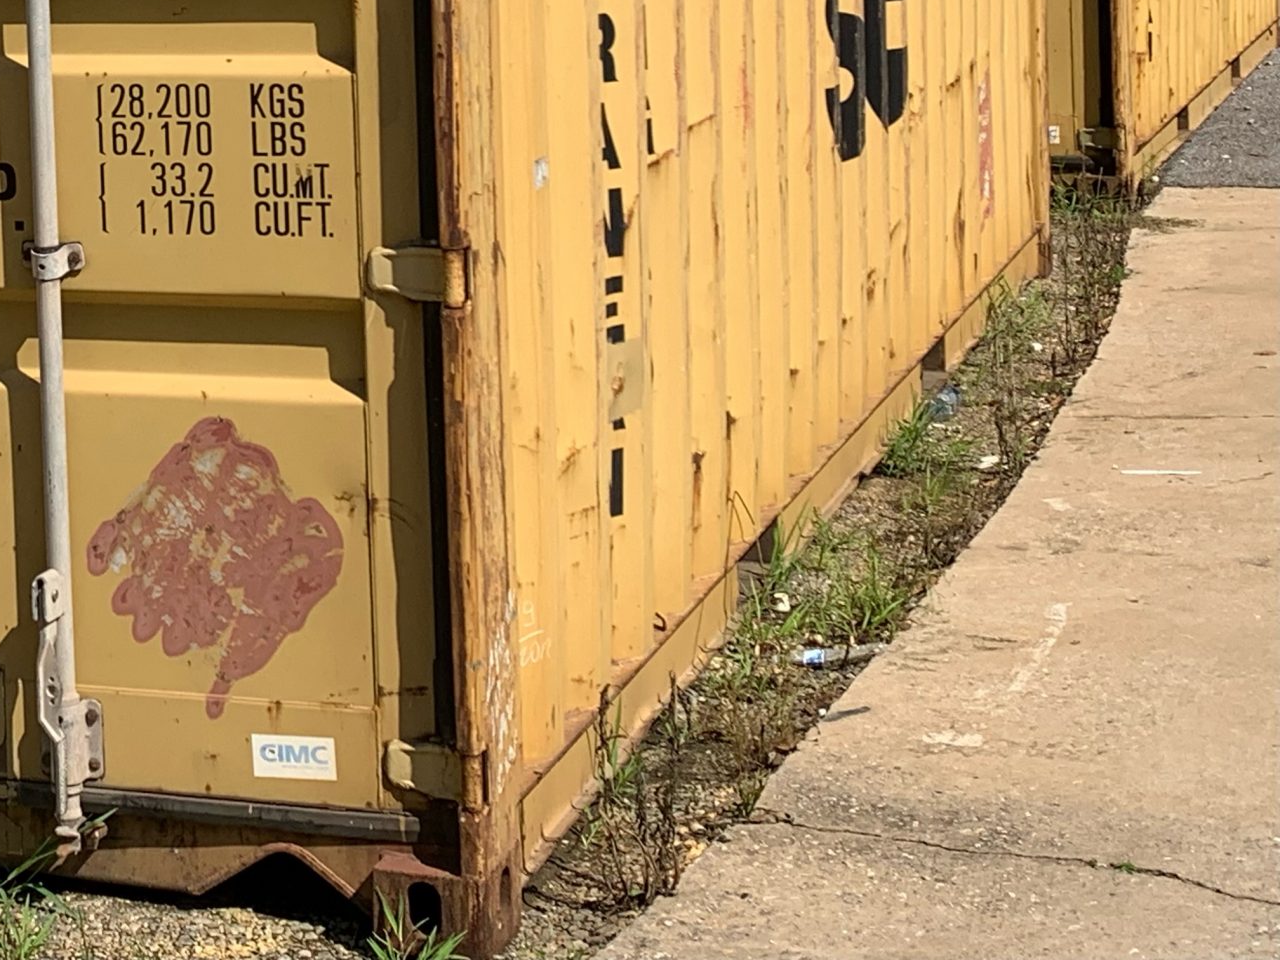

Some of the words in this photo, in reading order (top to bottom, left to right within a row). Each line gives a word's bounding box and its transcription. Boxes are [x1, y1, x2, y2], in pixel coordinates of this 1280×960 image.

[110, 83, 211, 119] 28,200
[250, 82, 305, 119] KGS
[111, 121, 212, 157] 62,170
[251, 121, 307, 157] LBS
[150, 162, 214, 198] 33.2
[136, 199, 216, 236] 1,170
[254, 200, 334, 238] CU.FT.
[259, 744, 329, 765] CIMC
